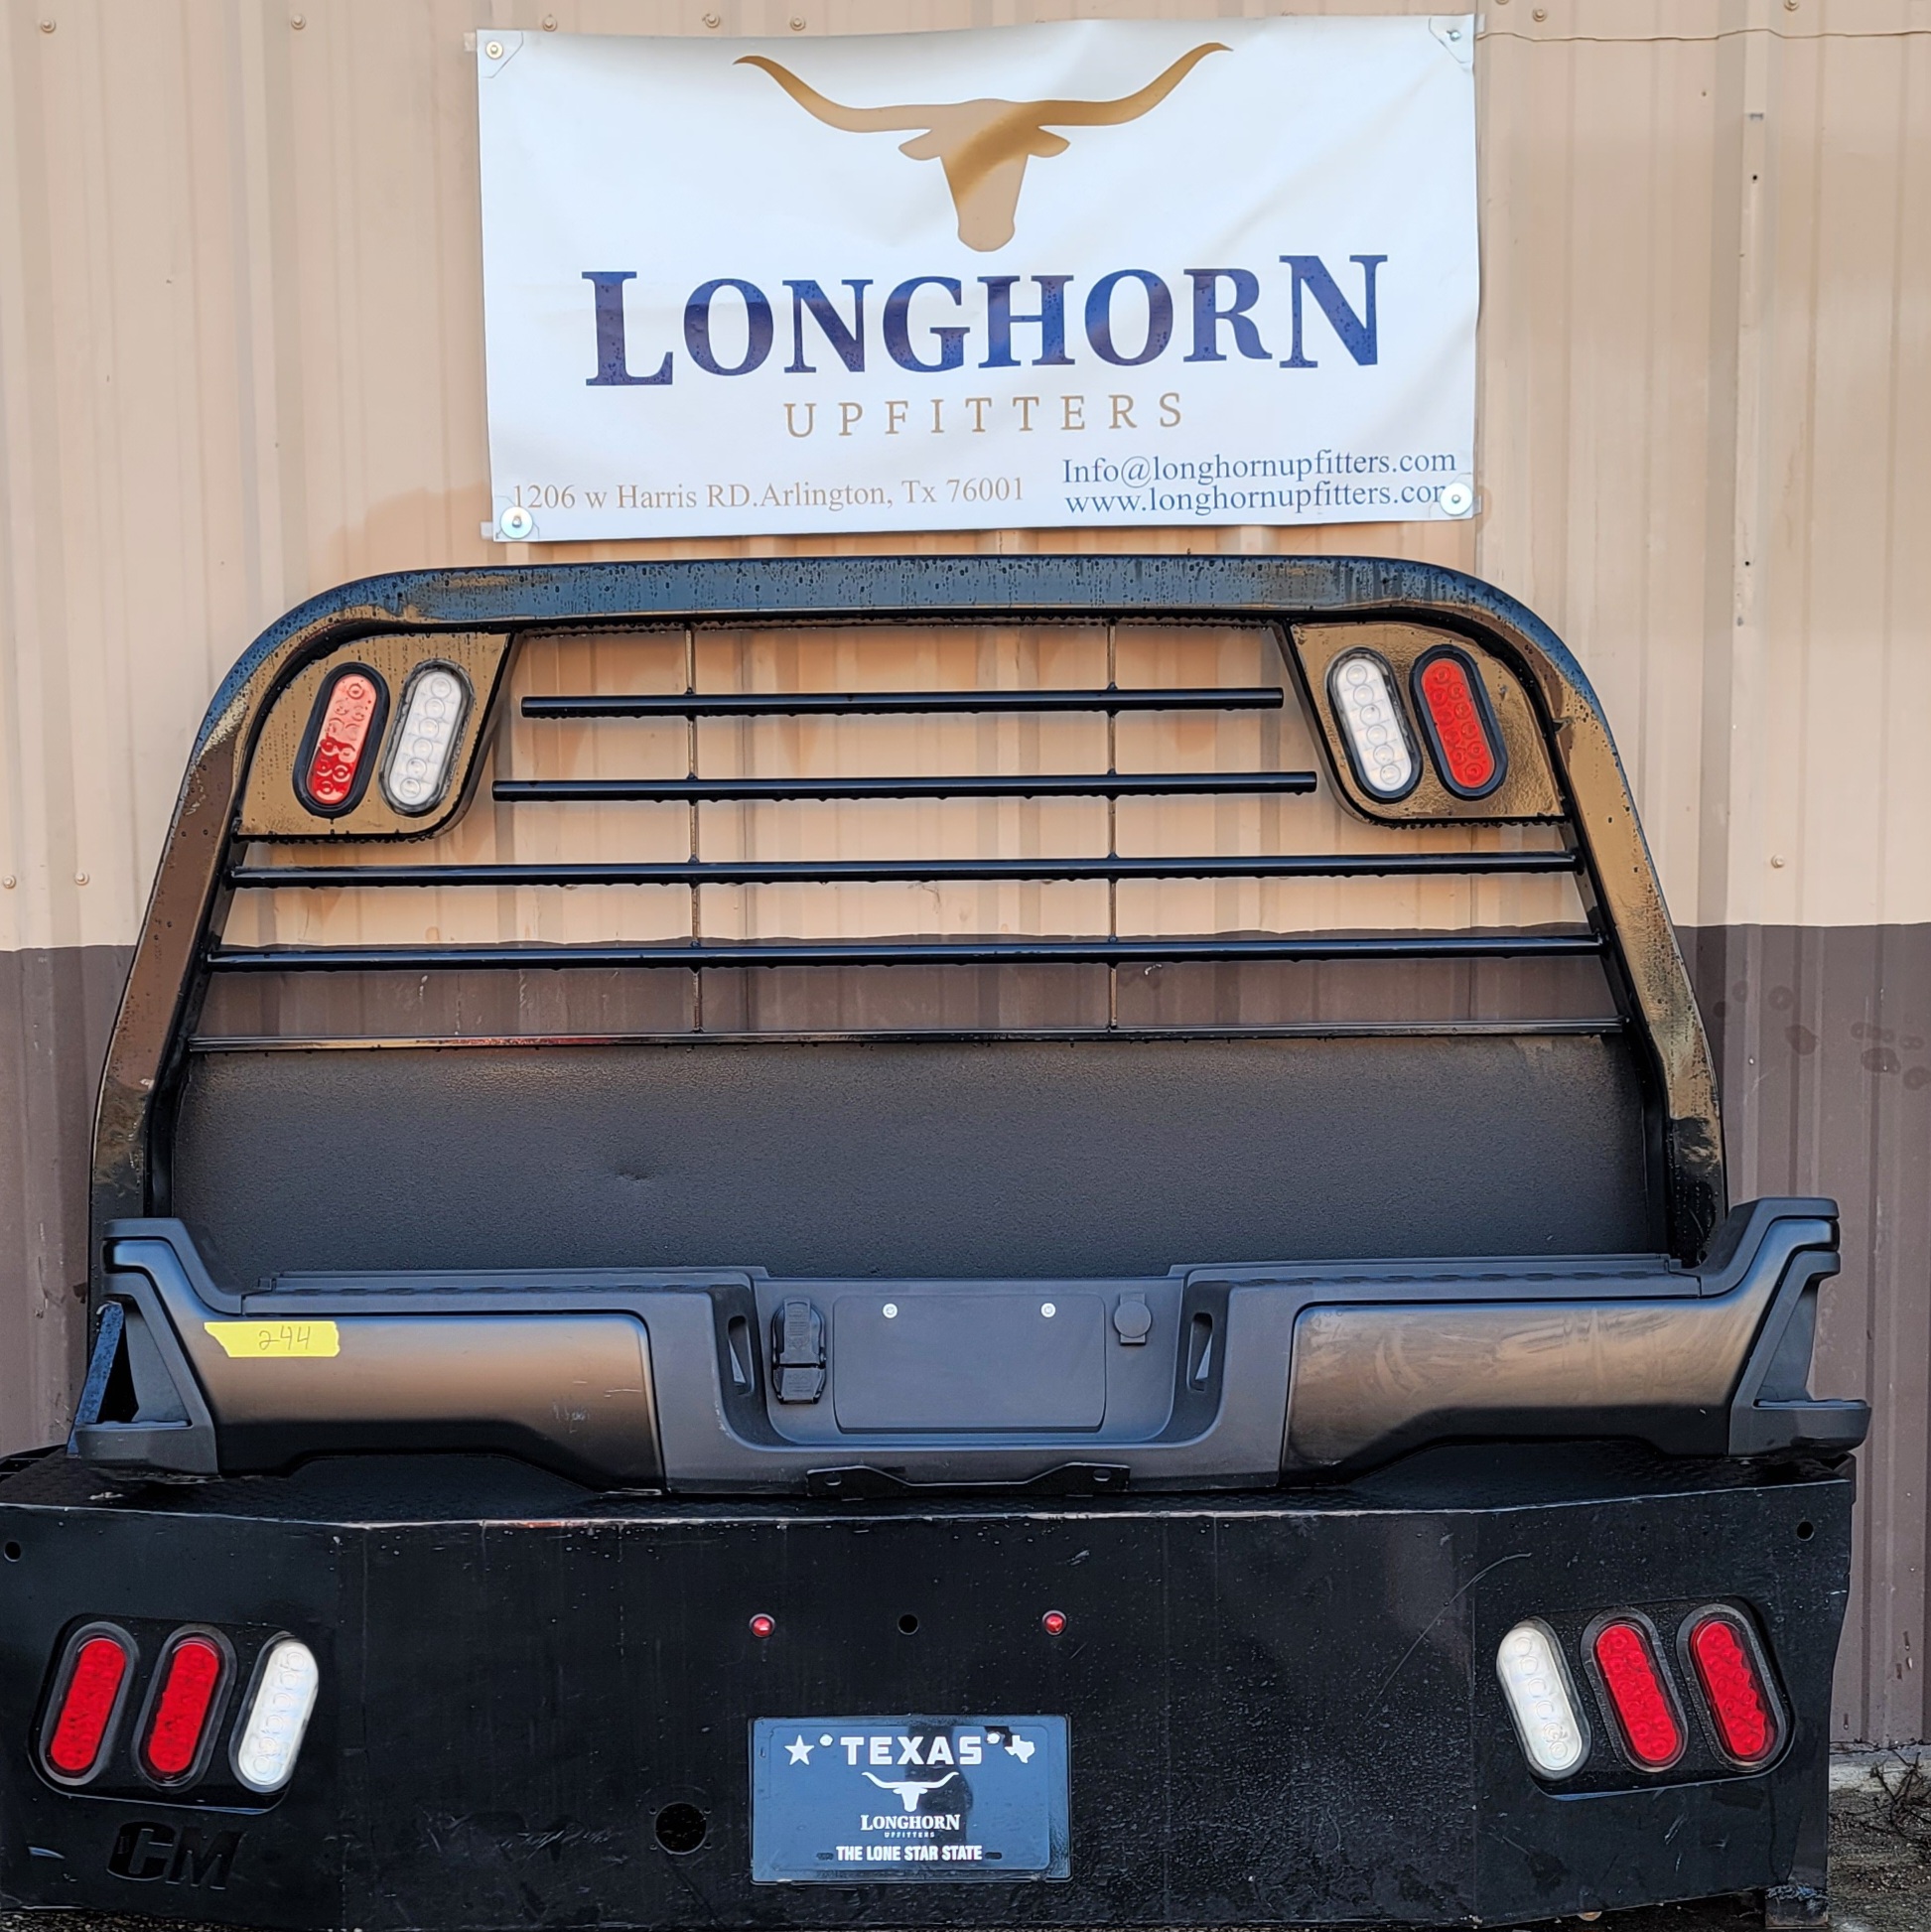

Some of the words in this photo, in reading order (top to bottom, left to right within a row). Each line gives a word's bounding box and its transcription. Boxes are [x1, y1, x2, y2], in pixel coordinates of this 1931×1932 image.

[582, 255, 1388, 385] LONGHORN
[783, 392, 1181, 438] UPFITTERS
[1062, 450, 1456, 487] Info@longhornupfitters.com
[513, 484, 575, 508] 1206
[585, 491, 607, 508] w
[617, 483, 697, 508] Harris
[901, 480, 936, 502] Tx
[945, 478, 1023, 501] 76001
[258, 1325, 311, 1351] 244
[840, 1736, 982, 1765] TEXAS
[860, 1814, 960, 1831] LONGHORN
[836, 1846, 863, 1861] THE
[867, 1846, 900, 1861] LONE
[904, 1846, 938, 1861] STAR
[941, 1845, 982, 1861] STATE
